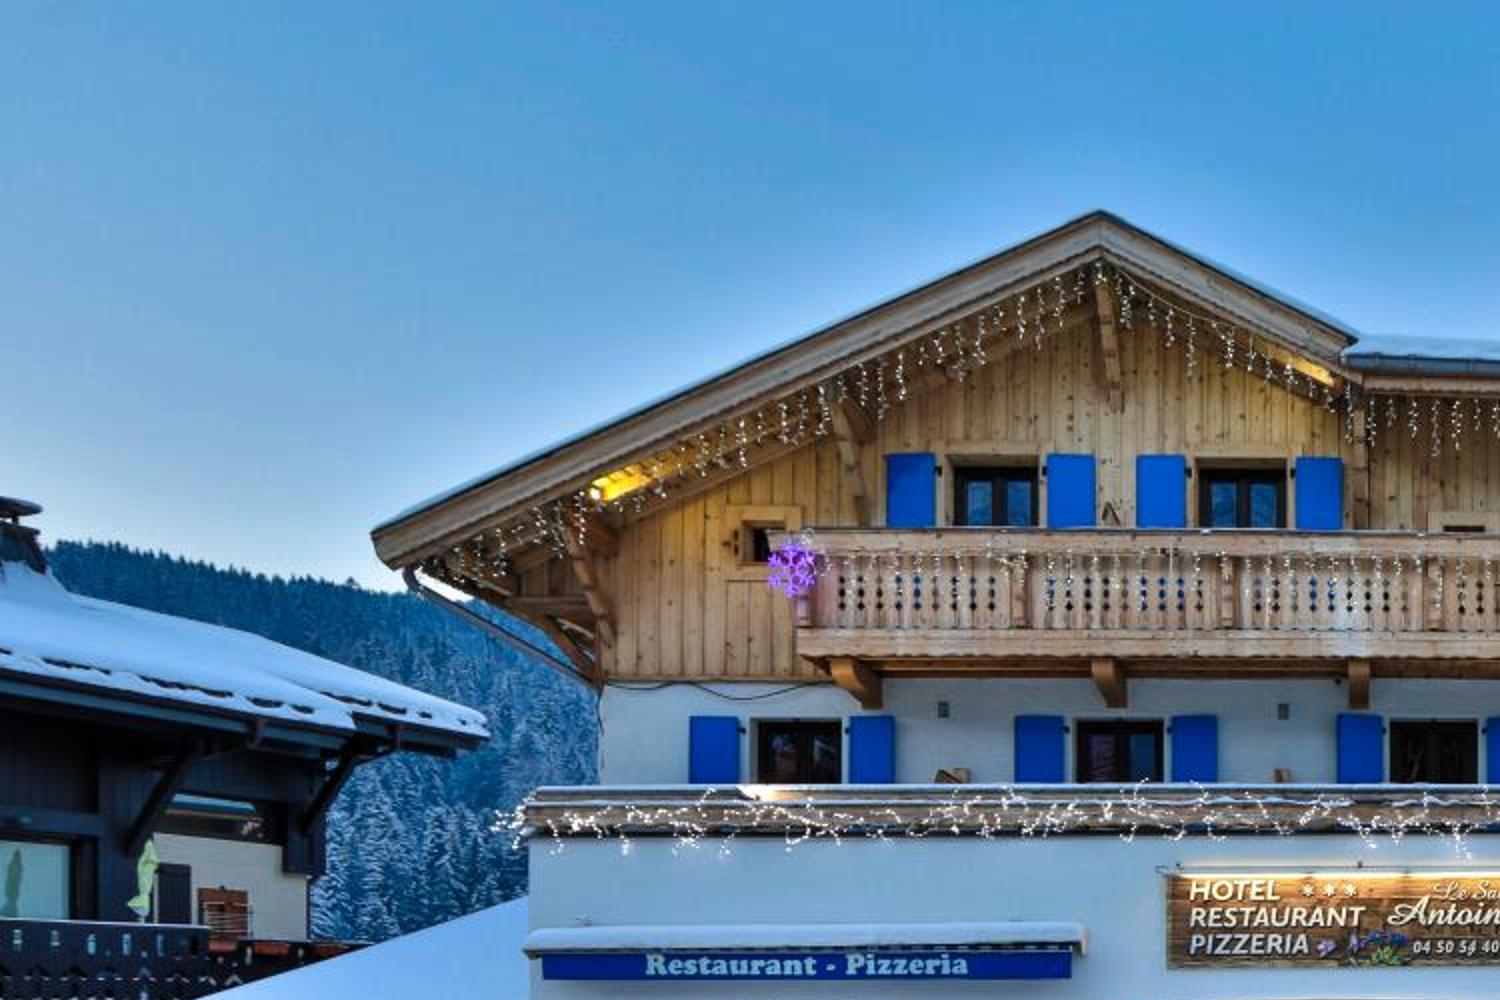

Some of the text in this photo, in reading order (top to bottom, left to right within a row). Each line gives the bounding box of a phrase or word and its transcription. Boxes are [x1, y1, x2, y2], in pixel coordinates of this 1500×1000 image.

[1189, 879, 1281, 901] HOTEL
[1433, 881, 1470, 901] Le
[1189, 906, 1367, 928] RESTAURANT
[1189, 933, 1310, 955] PIZZERIA
[1413, 940, 1431, 954] 04
[1436, 940, 1455, 953] 50
[1481, 940, 1500, 953] 40
[645, 954, 816, 976] Restaurant
[845, 953, 968, 976] Pizzeria
